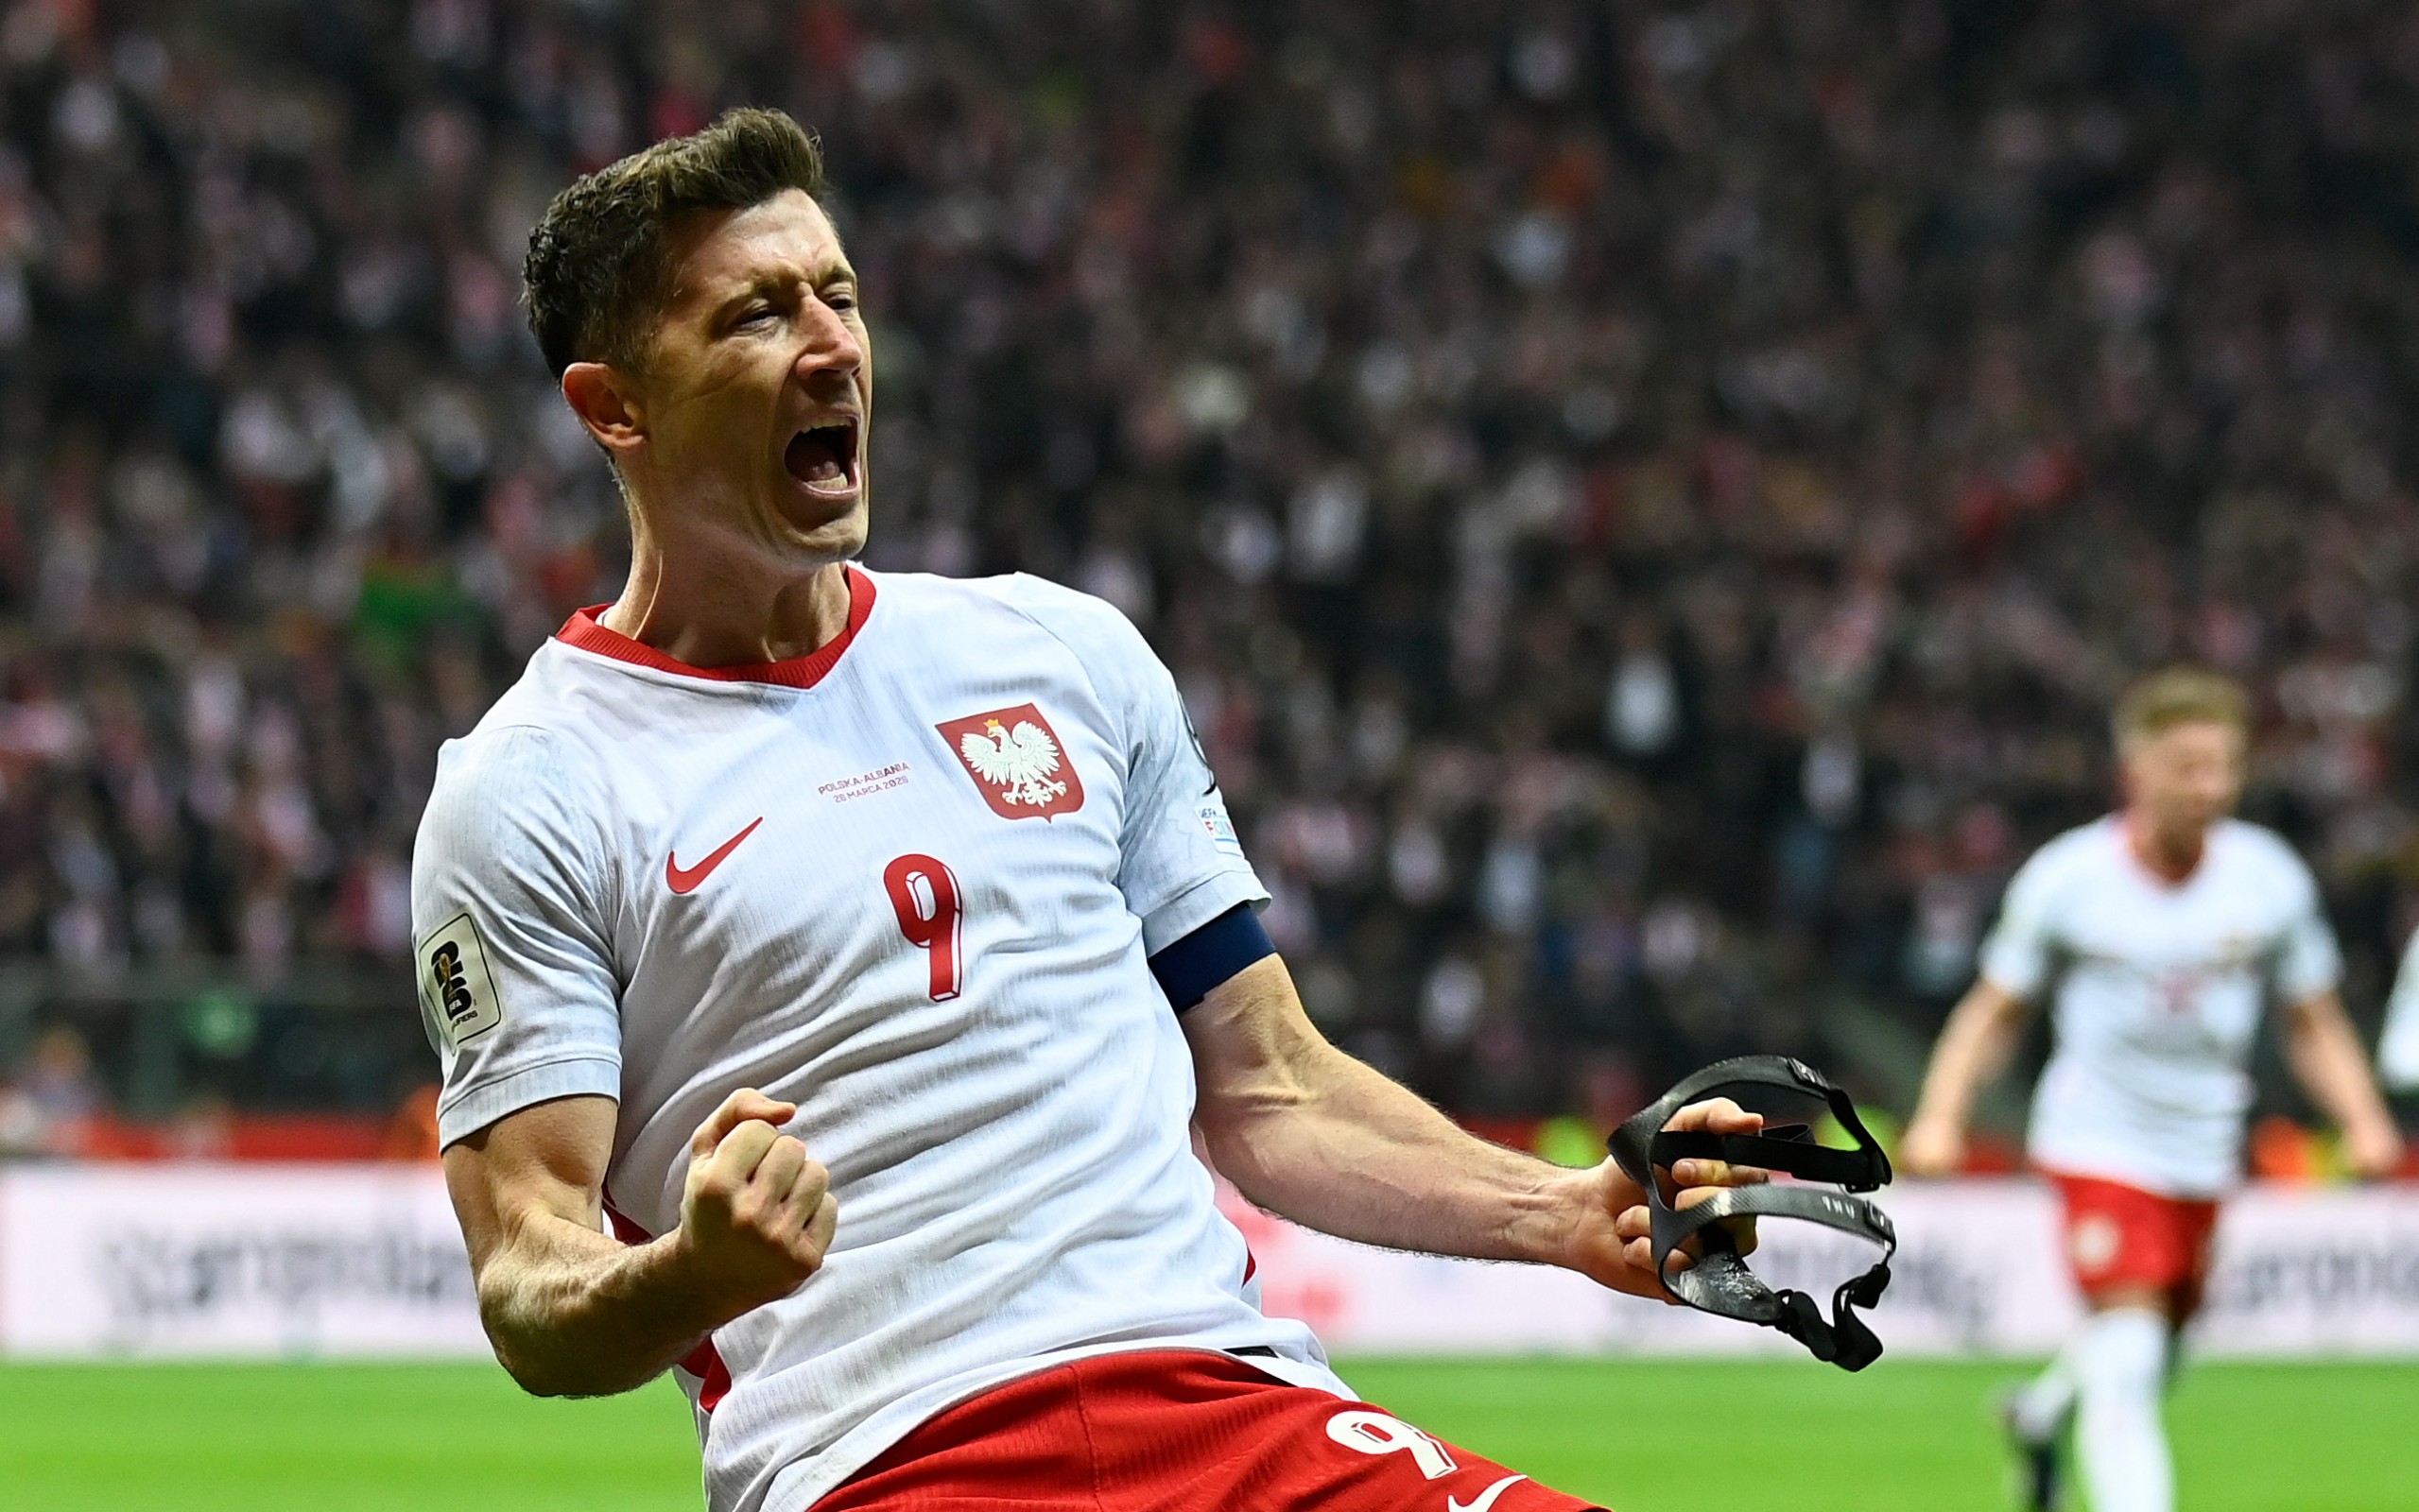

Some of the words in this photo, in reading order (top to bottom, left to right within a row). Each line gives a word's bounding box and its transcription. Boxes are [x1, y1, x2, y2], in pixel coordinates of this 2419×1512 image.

[847, 783, 882, 800] MARCA
[884, 853, 963, 1003] 9
[1326, 1410, 1458, 1481] 9
